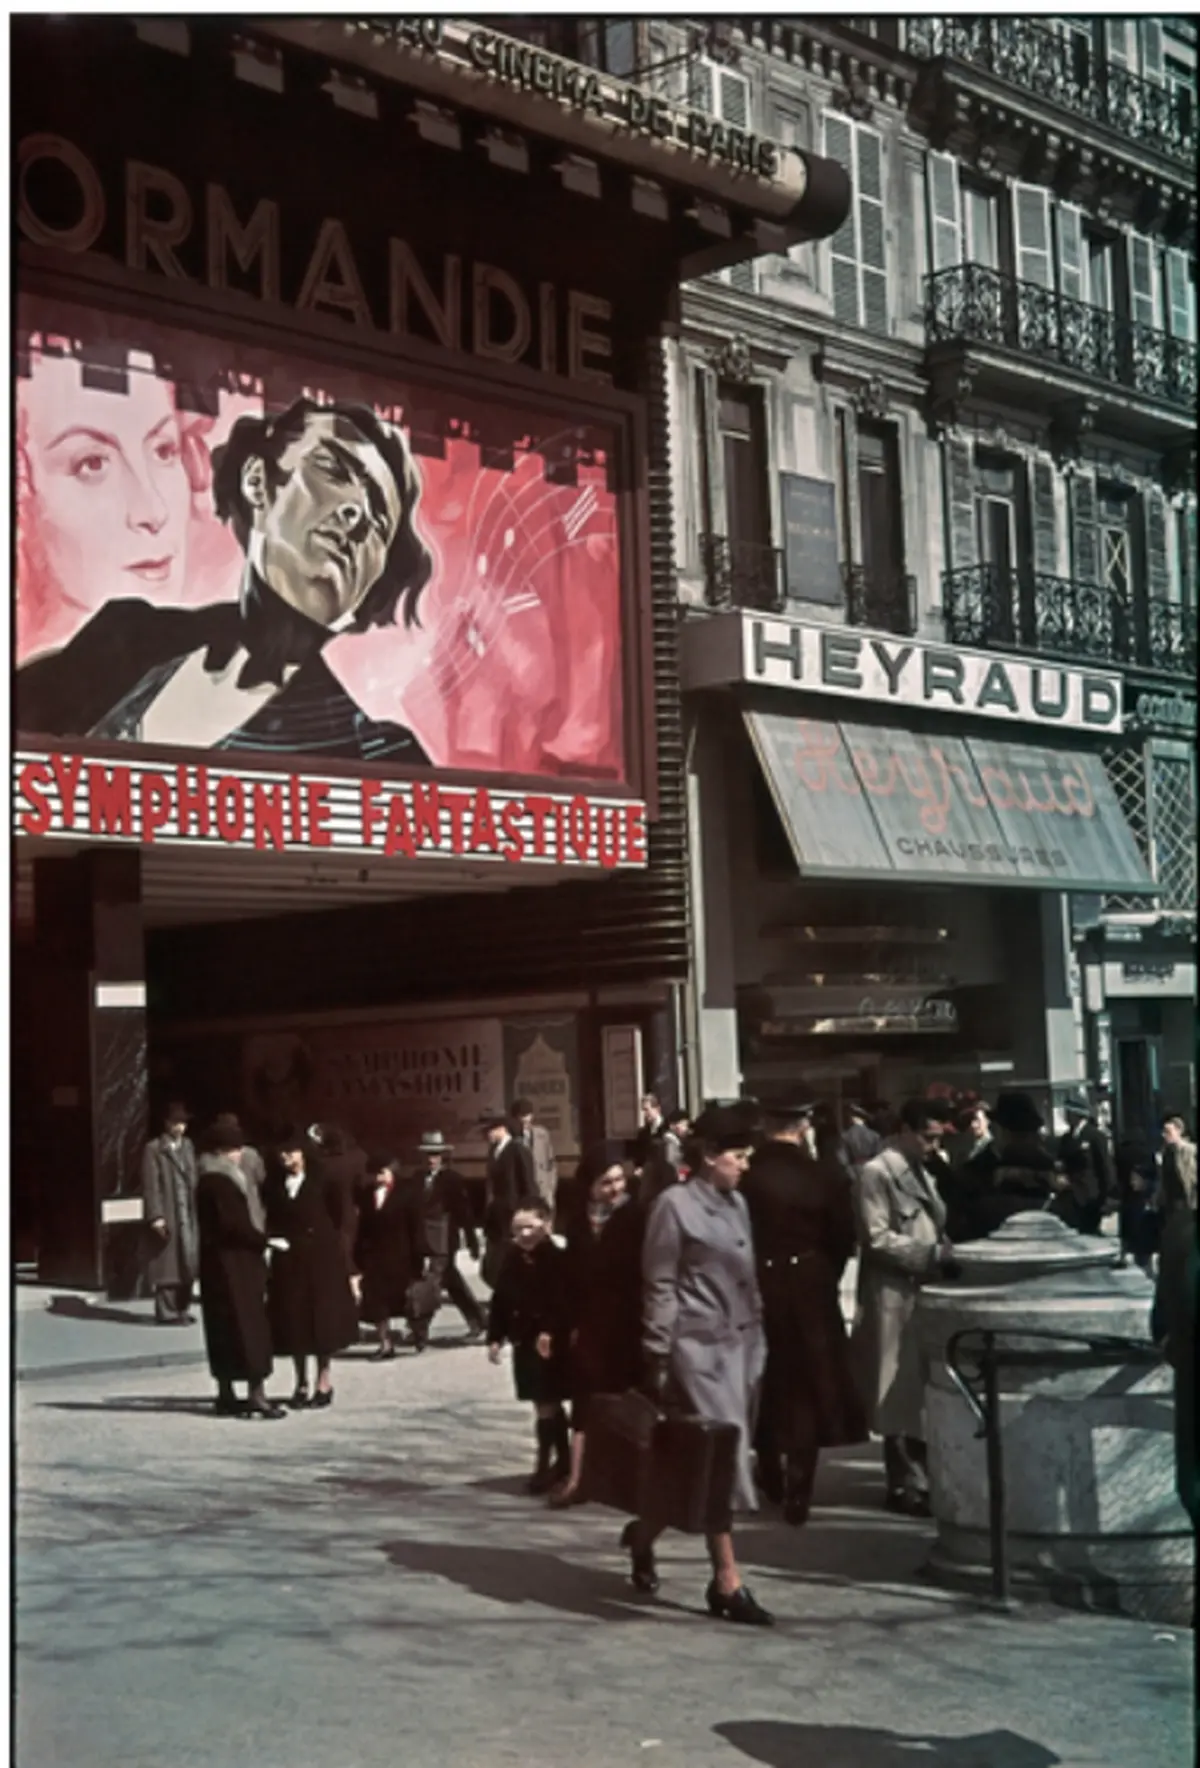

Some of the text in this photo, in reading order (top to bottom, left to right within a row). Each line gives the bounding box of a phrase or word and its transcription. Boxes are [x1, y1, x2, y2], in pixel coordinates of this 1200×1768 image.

[468, 31, 606, 116] CINEMA
[627, 87, 669, 138] DE
[689, 113, 780, 178] PARIS
[16, 132, 613, 387] ORMANDIE
[752, 621, 1118, 726] HEYRAUD
[17, 753, 646, 868] SYMPHONIE FANTASTIQUE
[795, 717, 1093, 834] Heyraud
[896, 836, 1068, 867] CHAUSSURES
